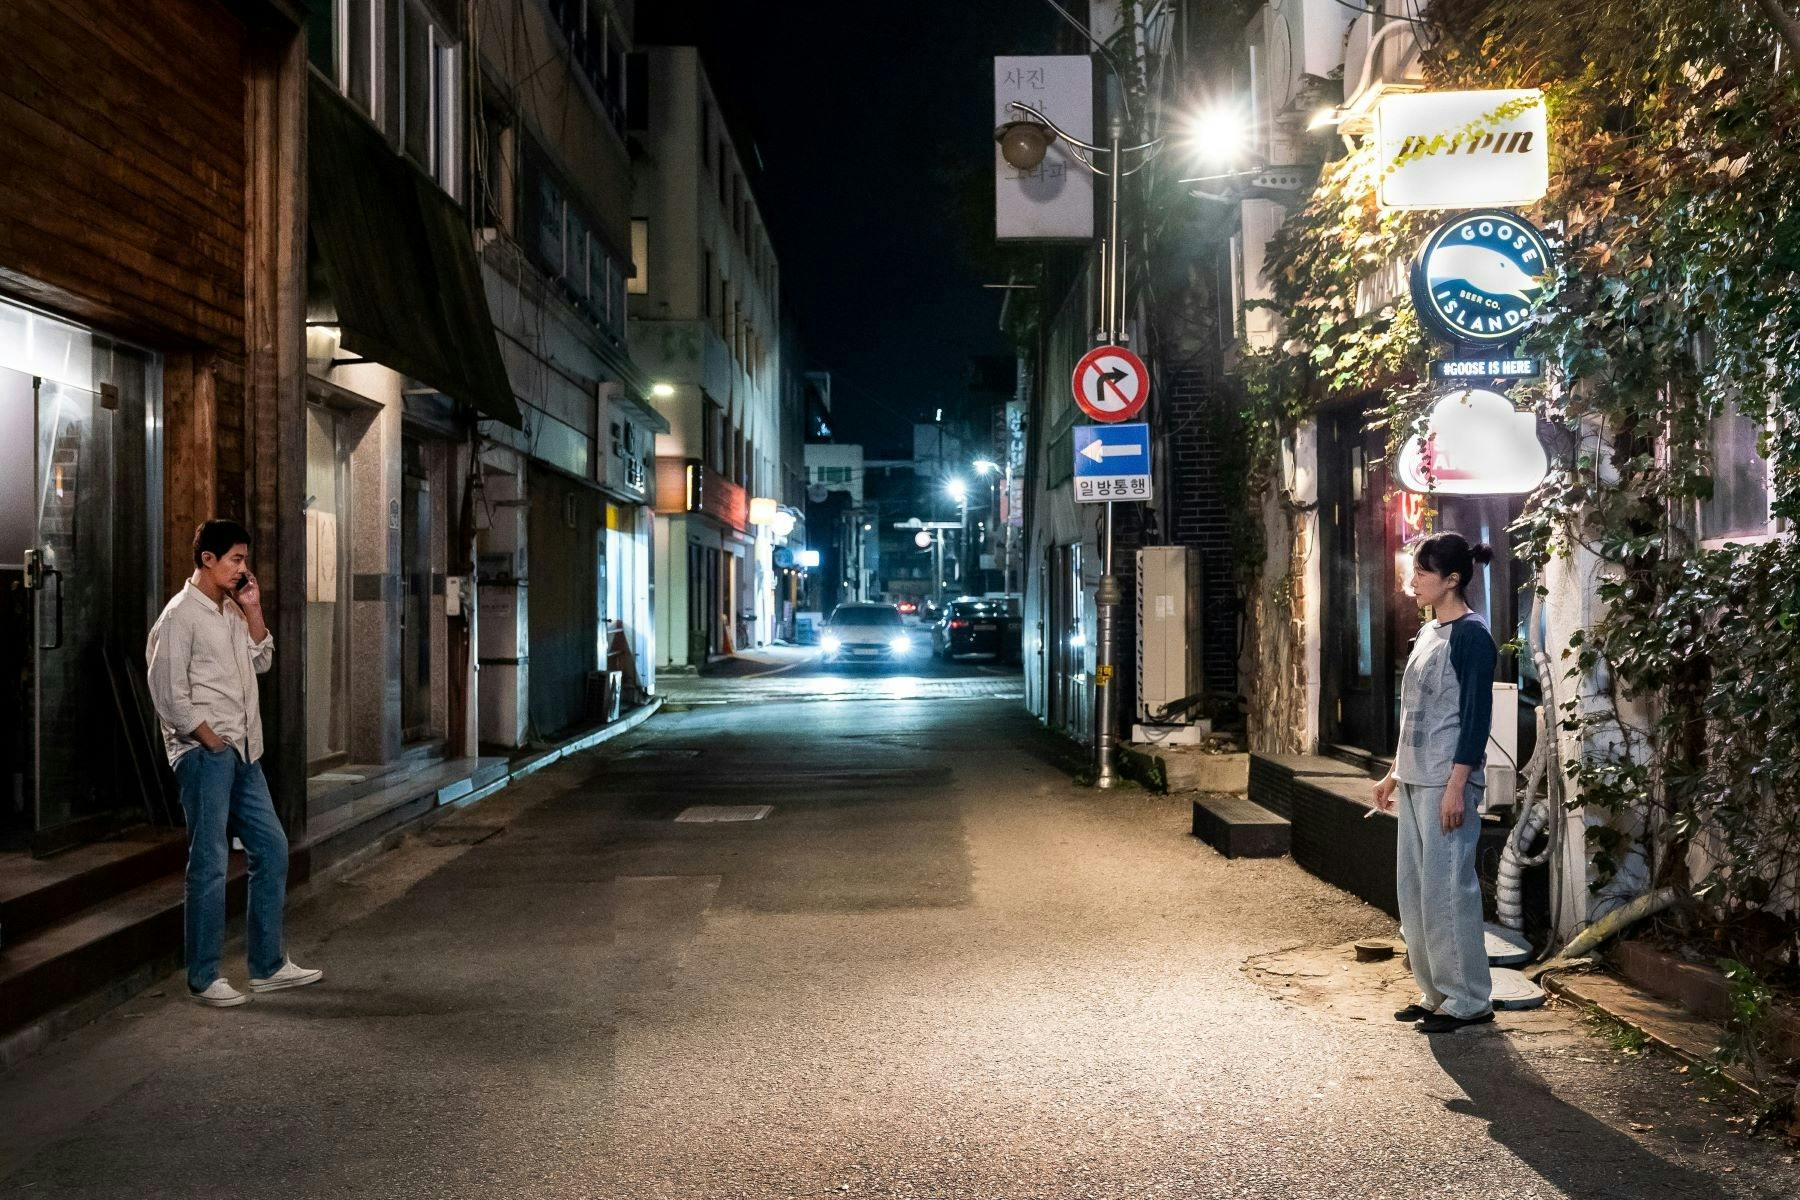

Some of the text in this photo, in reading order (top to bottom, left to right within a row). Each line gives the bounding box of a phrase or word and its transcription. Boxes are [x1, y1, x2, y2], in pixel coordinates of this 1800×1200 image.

[1003, 67, 1046, 90] 사진
[1461, 221, 1538, 263] GOOSE
[1460, 289, 1484, 304] BEER
[1437, 290, 1520, 332] ISLAND
[1443, 360, 1532, 376] #GOOSE IS HERE
[1080, 478, 1146, 497] 일방통행
